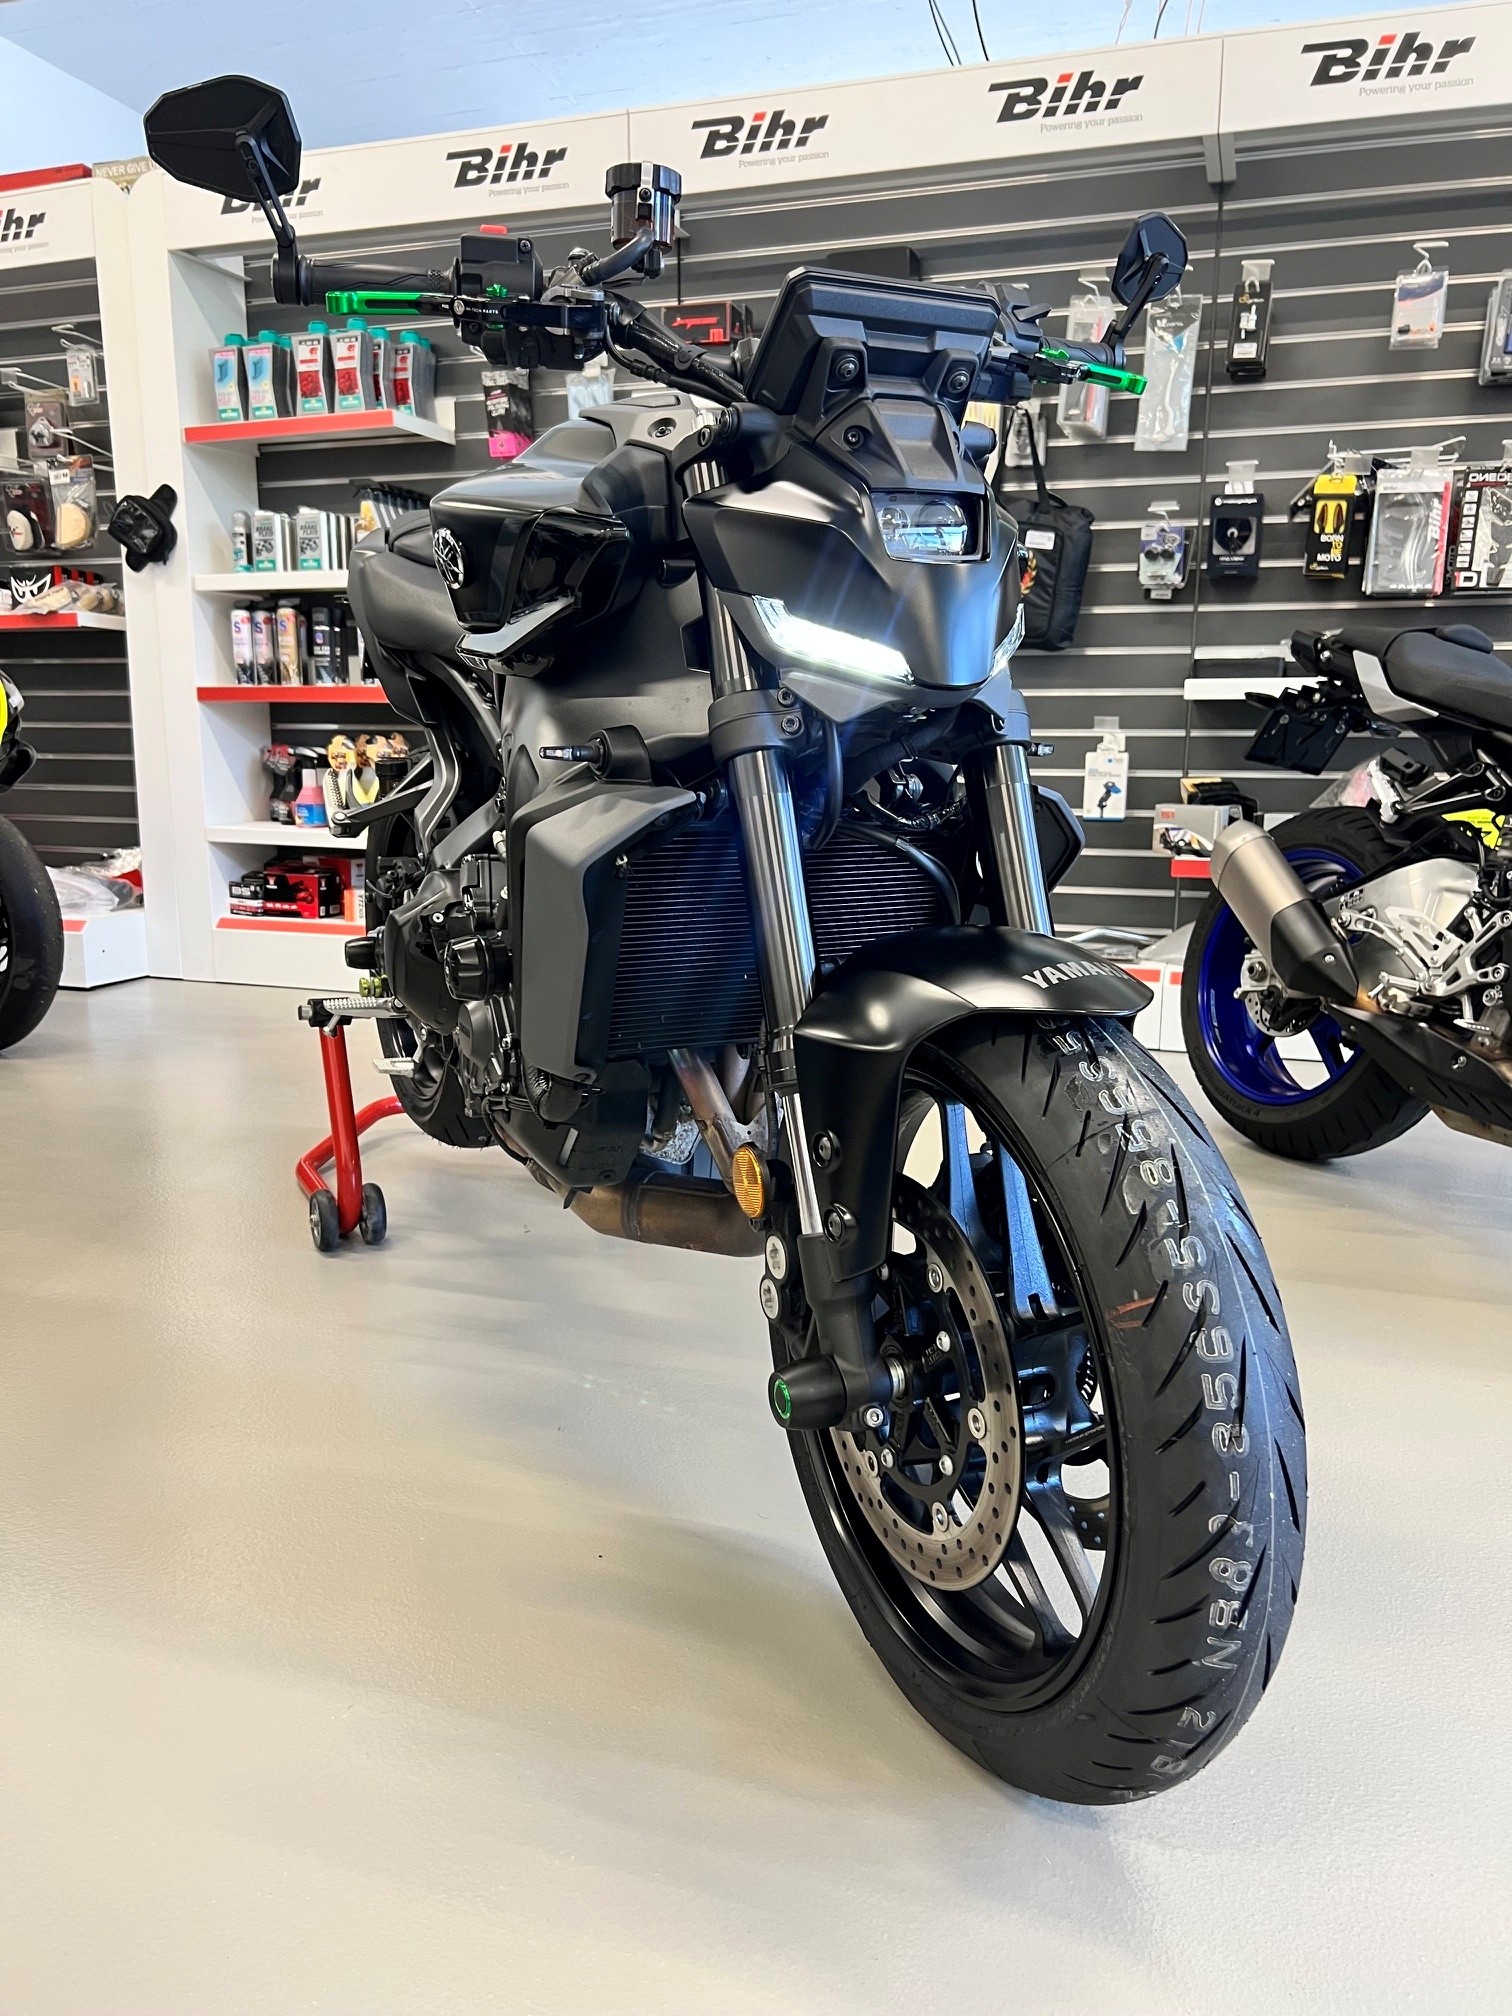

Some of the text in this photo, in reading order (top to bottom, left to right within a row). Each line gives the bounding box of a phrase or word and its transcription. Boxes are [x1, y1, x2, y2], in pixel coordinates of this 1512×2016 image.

[1301, 31, 1477, 86] Bihr
[988, 70, 1144, 123] Bihr
[1358, 77, 1474, 97] Powering your passion
[1040, 113, 1143, 133] Powering your passion
[691, 109, 829, 159] Bihr
[95, 165, 126, 178] NEVER
[127, 160, 147, 174] GIVE
[446, 142, 568, 188] Bihr
[738, 151, 829, 169] Powering your passion
[1320, 534, 1345, 543] BORN
[1316, 553, 1342, 562] MOTO
